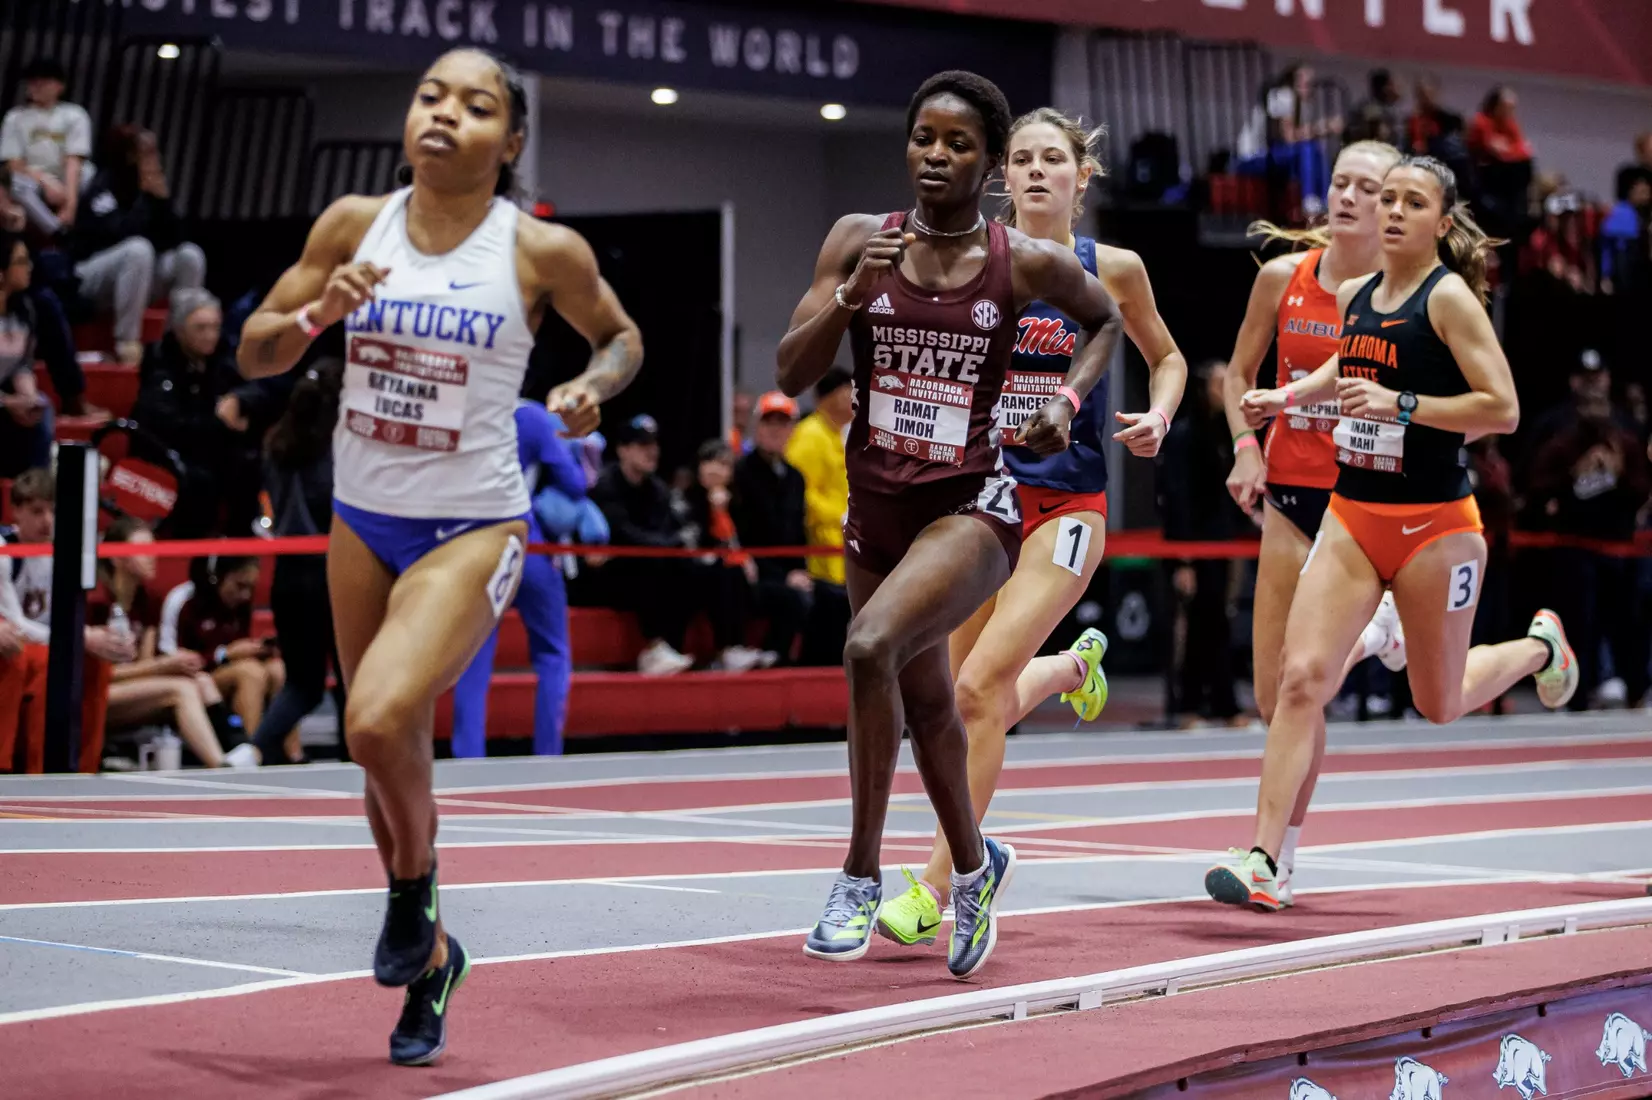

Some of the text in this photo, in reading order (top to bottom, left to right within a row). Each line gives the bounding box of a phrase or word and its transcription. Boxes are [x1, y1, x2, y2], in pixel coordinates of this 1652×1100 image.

[523, 3, 574, 50] IN
[597, 9, 687, 63] THE
[708, 21, 860, 79] WORLD
[868, 306, 895, 315] adidas
[974, 301, 998, 328] SEC
[345, 299, 504, 349] ENTUCKY
[1284, 317, 1344, 340] AUBU
[872, 325, 991, 354] MISSISSIPPI
[873, 344, 986, 383] STATE
[910, 377, 963, 395] RAZORBACK
[1014, 374, 1062, 385] RAZORBACK
[909, 387, 969, 406] INVITATIONAL
[894, 398, 940, 421] RAMAT
[894, 417, 935, 439] JIMOH
[1349, 435, 1375, 452] MAHI
[985, 480, 1010, 516] 2
[1068, 523, 1084, 569] 1
[1454, 565, 1472, 608] 3
